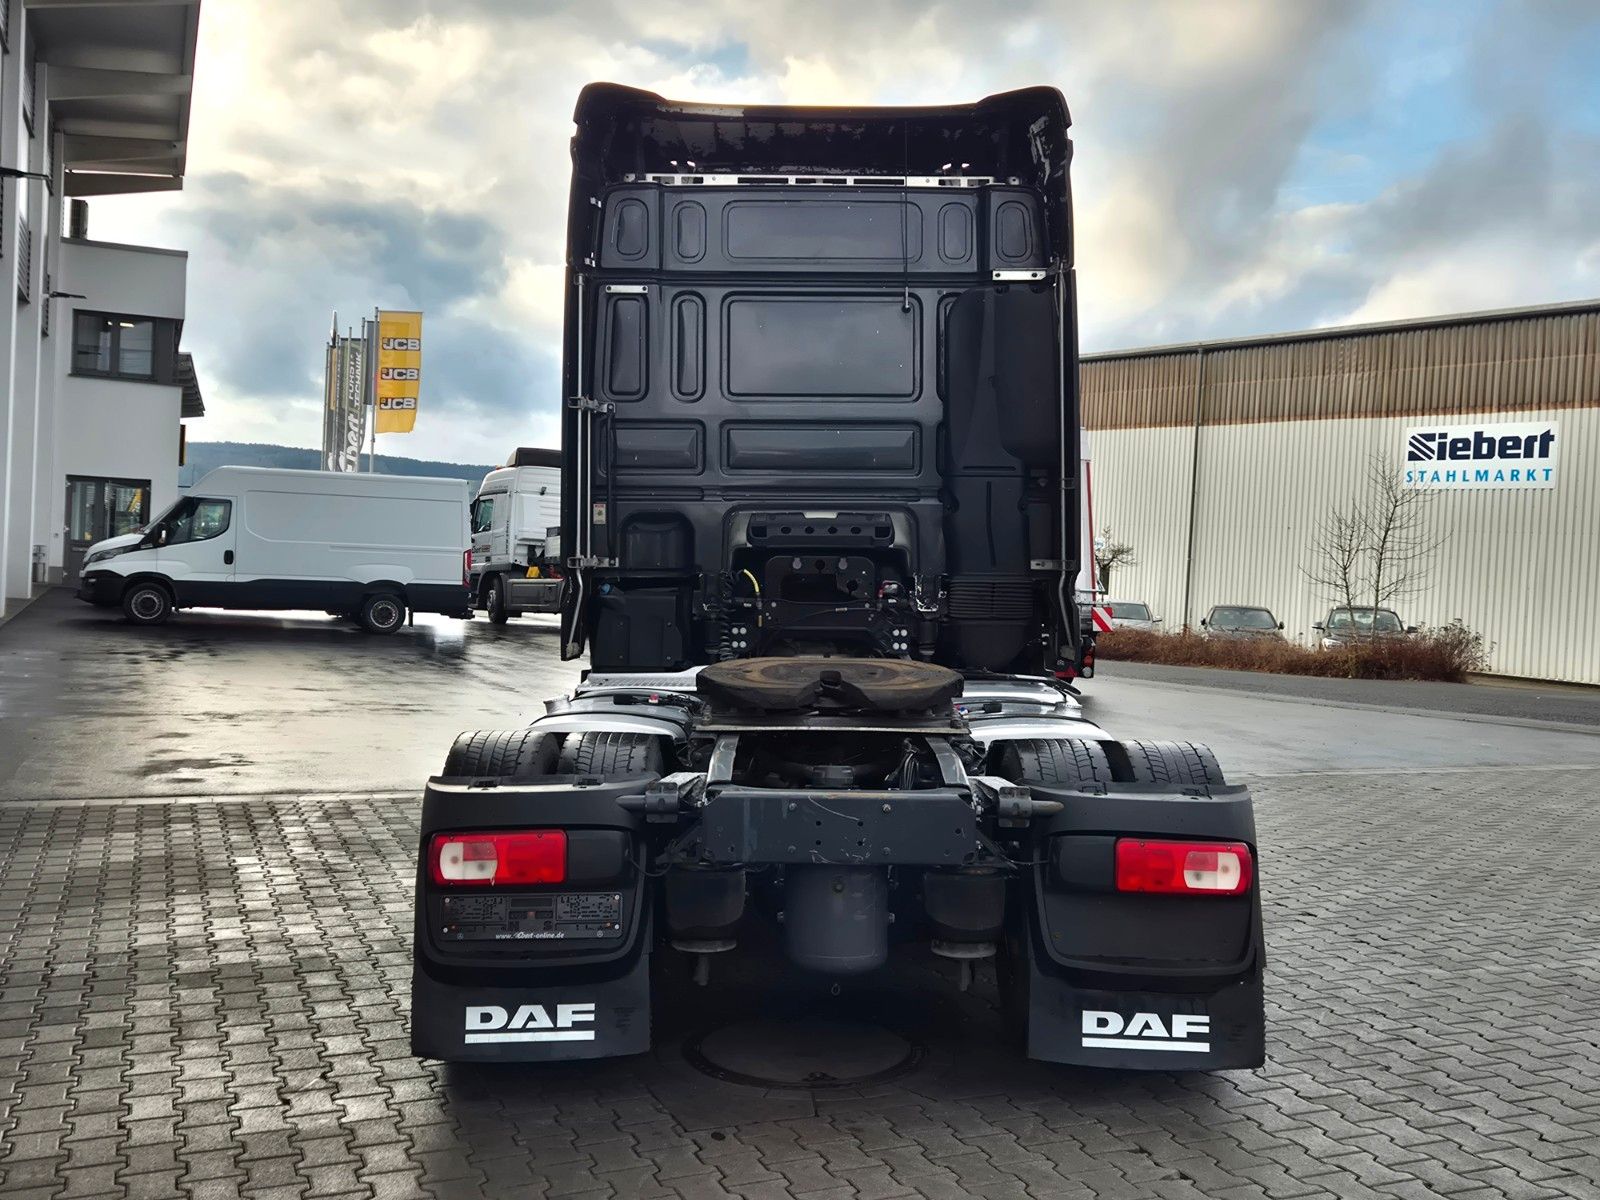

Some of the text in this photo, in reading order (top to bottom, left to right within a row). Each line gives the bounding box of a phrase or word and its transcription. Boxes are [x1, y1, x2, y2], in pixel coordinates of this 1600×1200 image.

[382, 337, 420, 351] JCB
[381, 368, 419, 380] JCB
[380, 398, 416, 410] JCB
[1408, 429, 1555, 461] Siebert
[1406, 469, 1553, 483] STAHLMARKT
[465, 1003, 595, 1030] DAF
[1082, 1010, 1210, 1038] DAF
